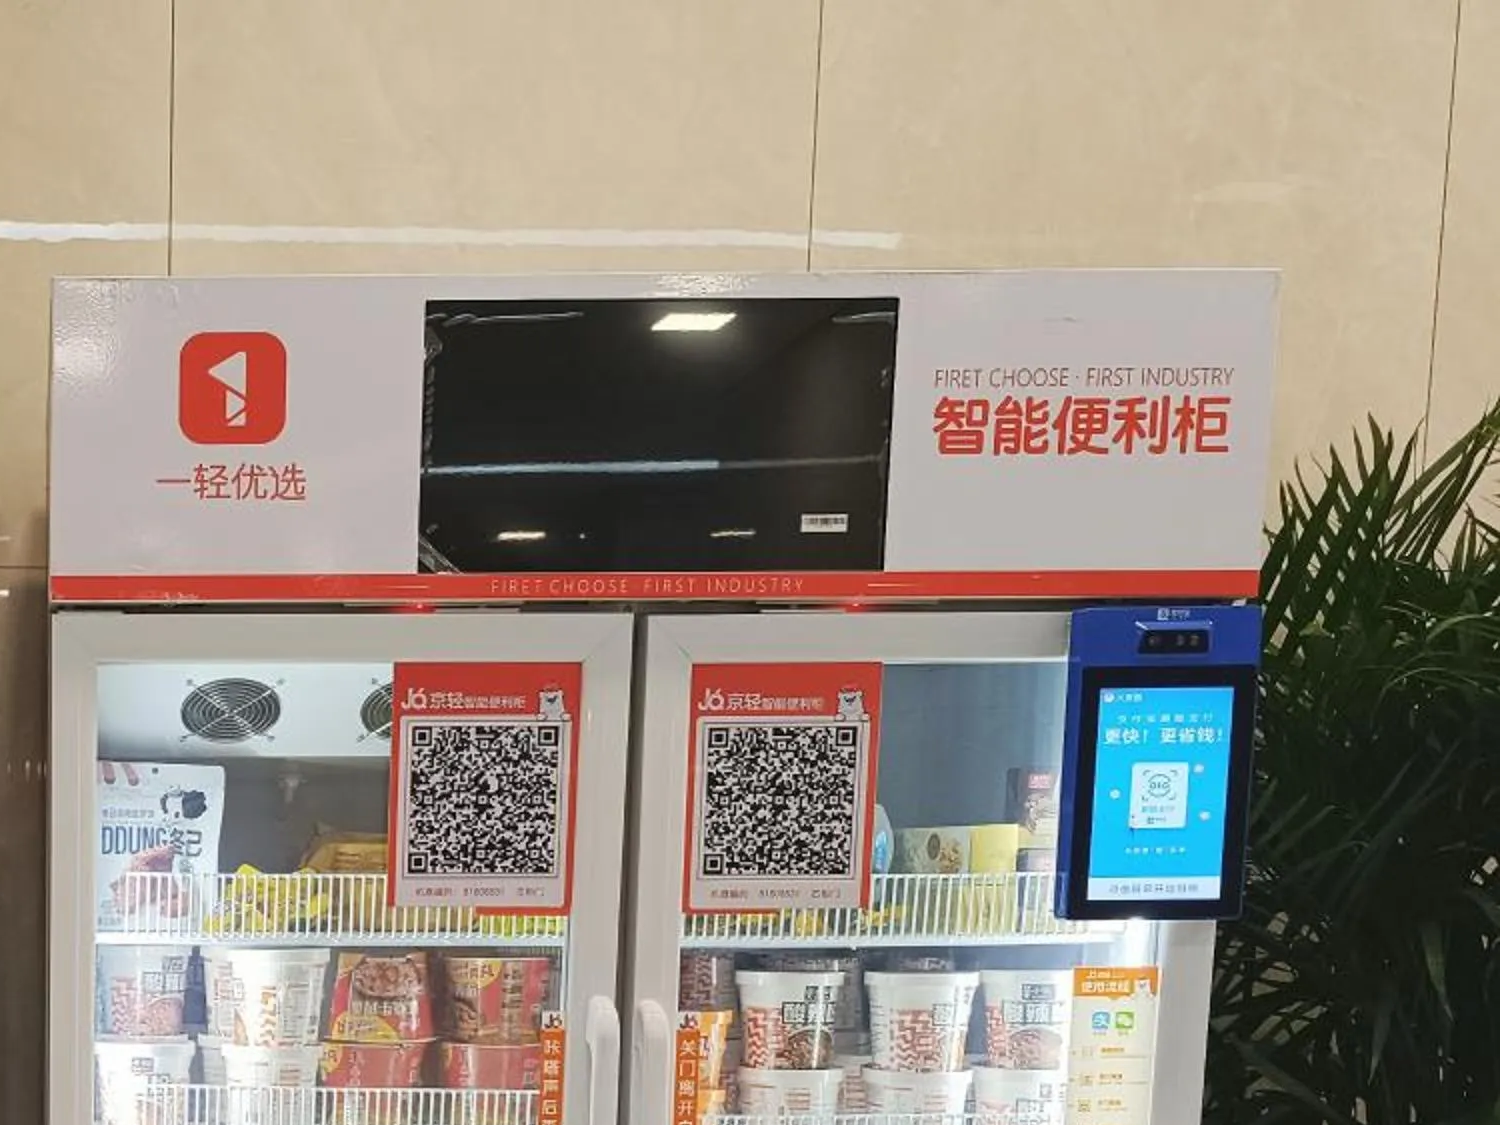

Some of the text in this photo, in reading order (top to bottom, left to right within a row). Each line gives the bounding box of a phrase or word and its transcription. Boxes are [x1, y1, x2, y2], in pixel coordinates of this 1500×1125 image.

[934, 367, 1235, 389] FIRET CHOOSE FIRST INDUSTRY
[932, 395, 1231, 456] 智能便利柜
[156, 463, 307, 501] 一轻优选
[550, 579, 629, 594] CHOOSE
[644, 579, 696, 594] FIRST
[706, 578, 804, 594] INDUSTRY
